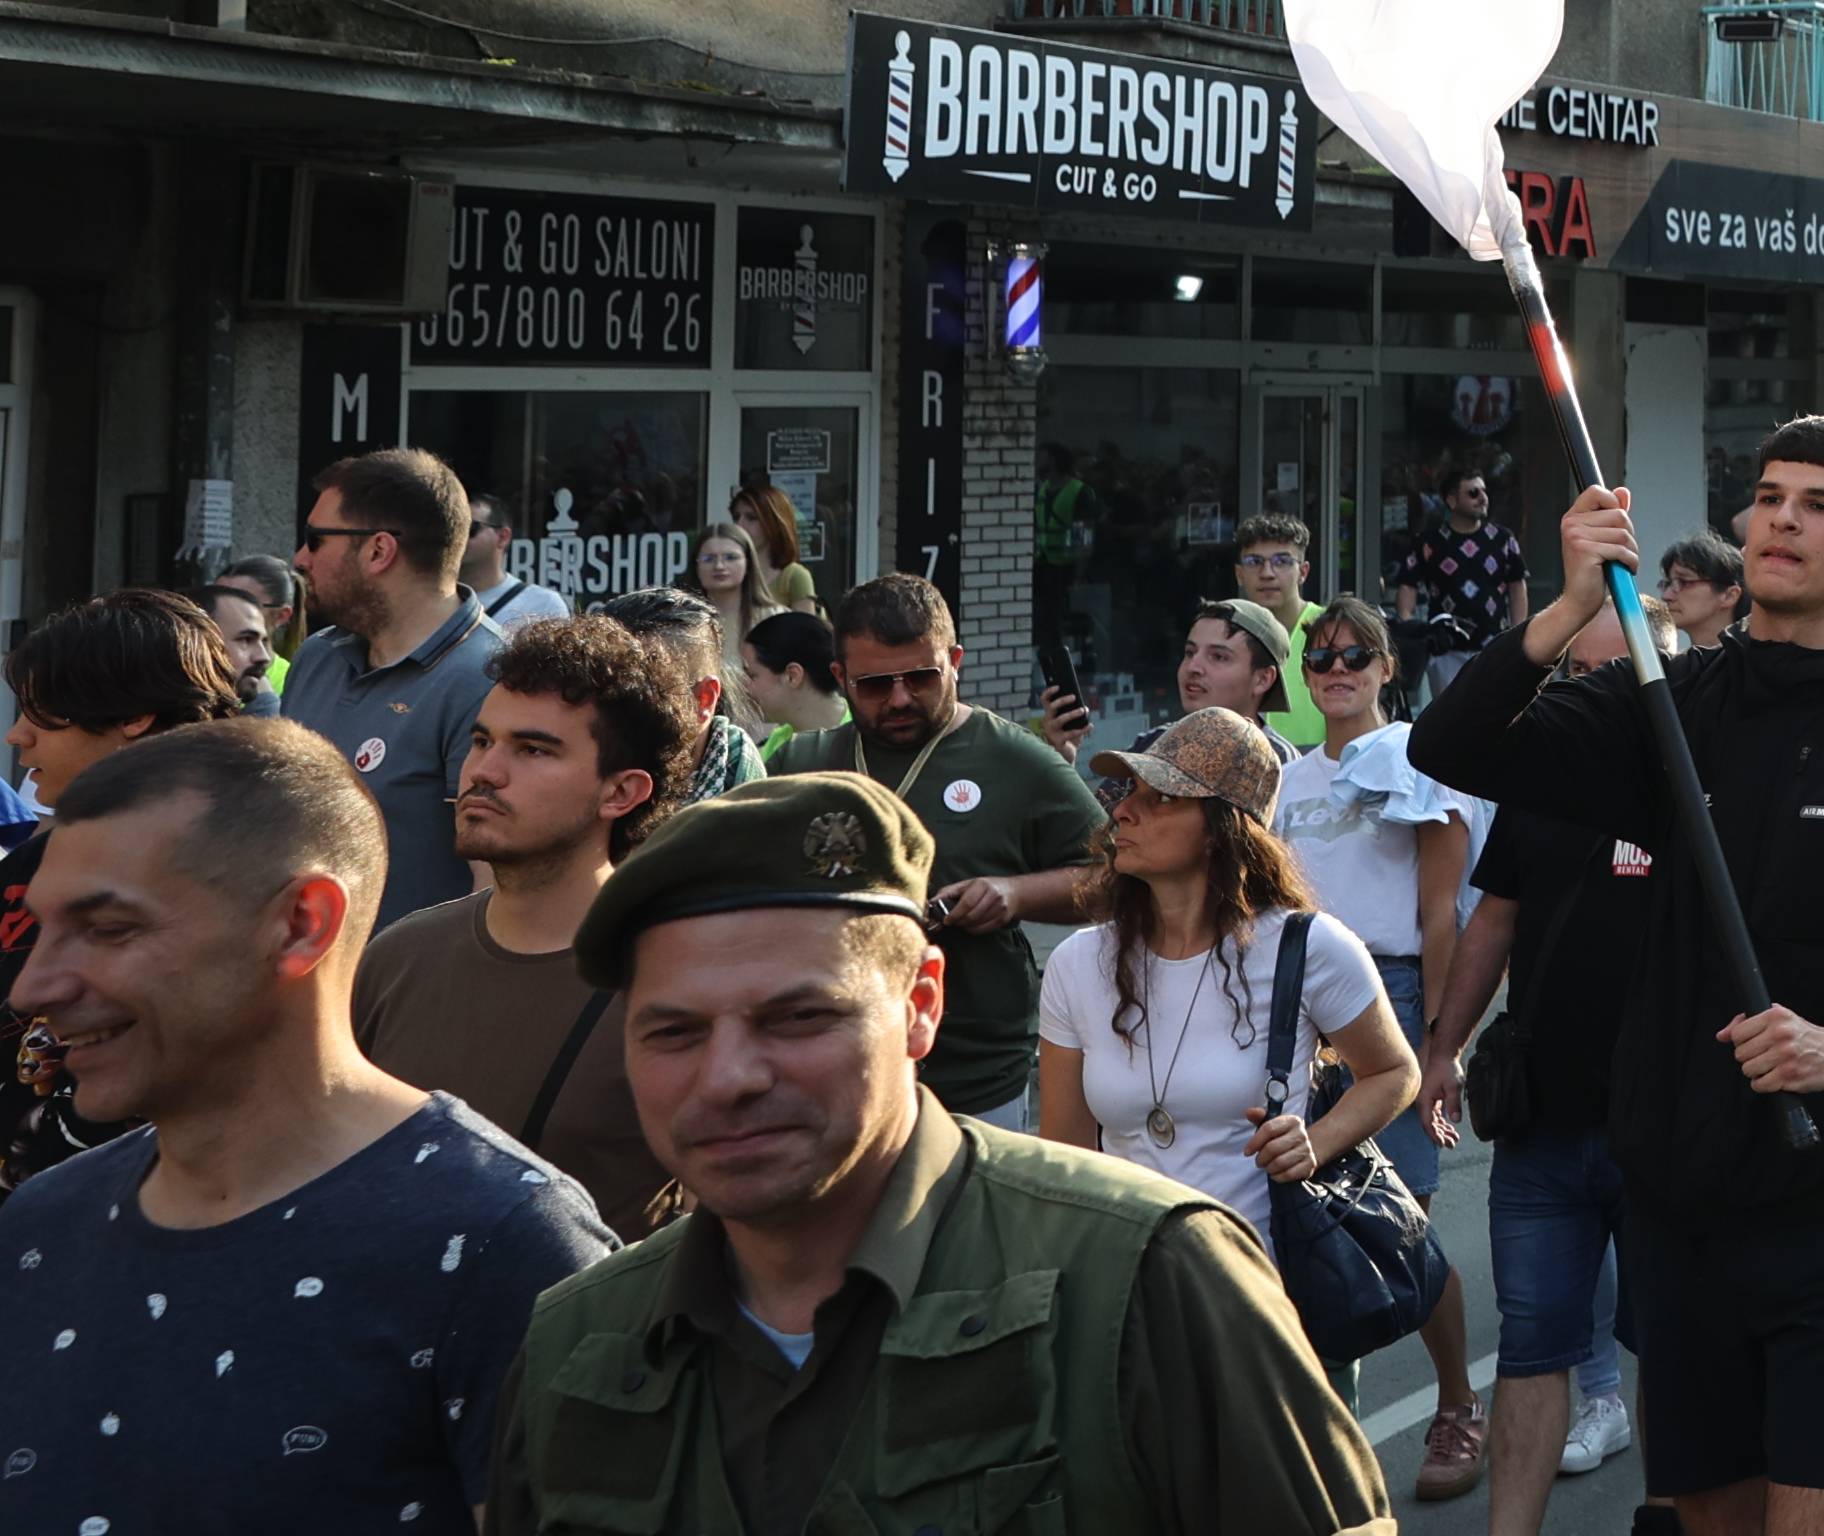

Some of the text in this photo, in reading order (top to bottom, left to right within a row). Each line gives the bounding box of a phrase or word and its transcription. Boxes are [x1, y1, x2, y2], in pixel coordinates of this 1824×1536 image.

[923, 37, 1269, 189] BARBERSHOP
[1547, 85, 1661, 147] CENTAR
[1055, 163, 1157, 203] CUT & GO
[1503, 169, 1597, 258] RA
[503, 210, 524, 274] &
[539, 212, 582, 276] GO
[594, 215, 701, 282] SALONI
[1666, 206, 1711, 245] sve
[1720, 212, 1747, 249] za
[1755, 207, 1796, 255] vaš
[739, 265, 868, 305] BARBERSHOP
[605, 289, 644, 351] 64
[663, 292, 701, 354] 26
[331, 371, 369, 444] M
[503, 530, 688, 595] BERSHOP
[1616, 866, 1646, 876] RENTAL
